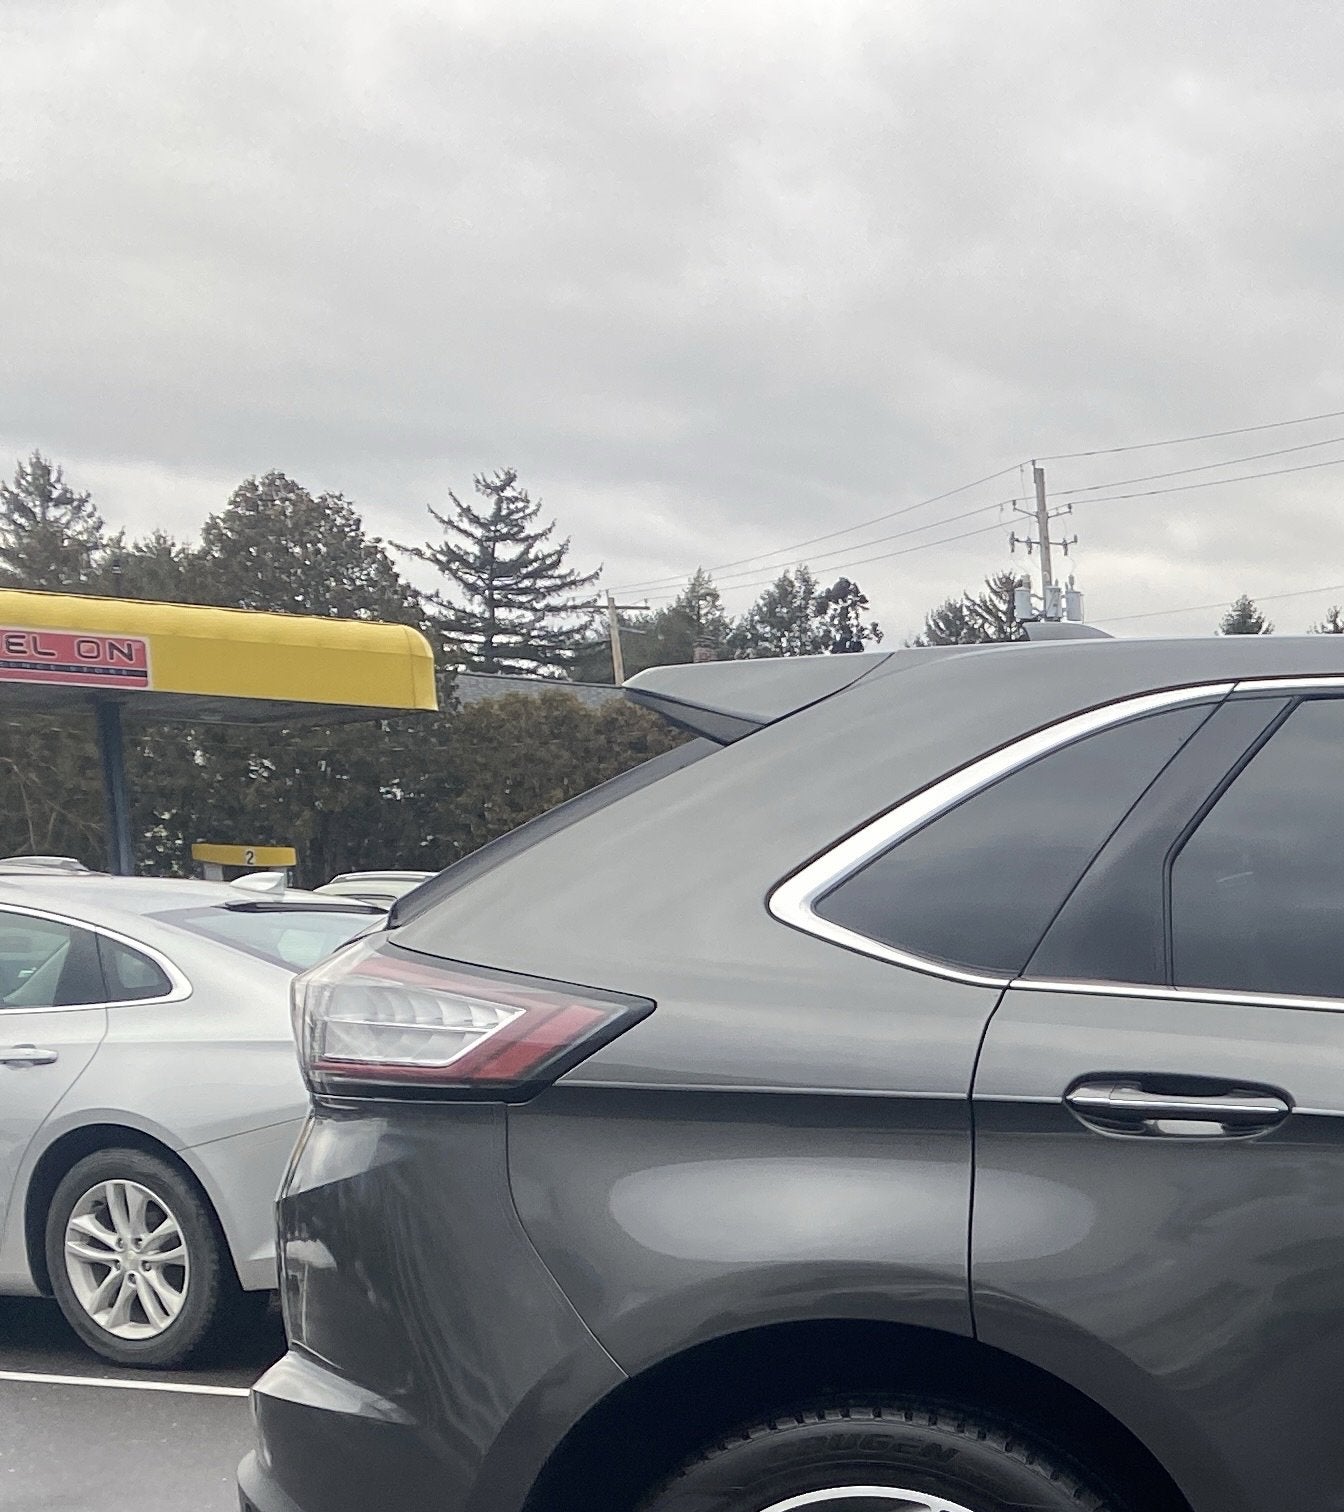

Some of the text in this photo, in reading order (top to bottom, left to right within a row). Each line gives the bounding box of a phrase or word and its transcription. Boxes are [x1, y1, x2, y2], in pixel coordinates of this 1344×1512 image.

[2, 633, 134, 662] EL ON
[245, 850, 254, 865] 2
